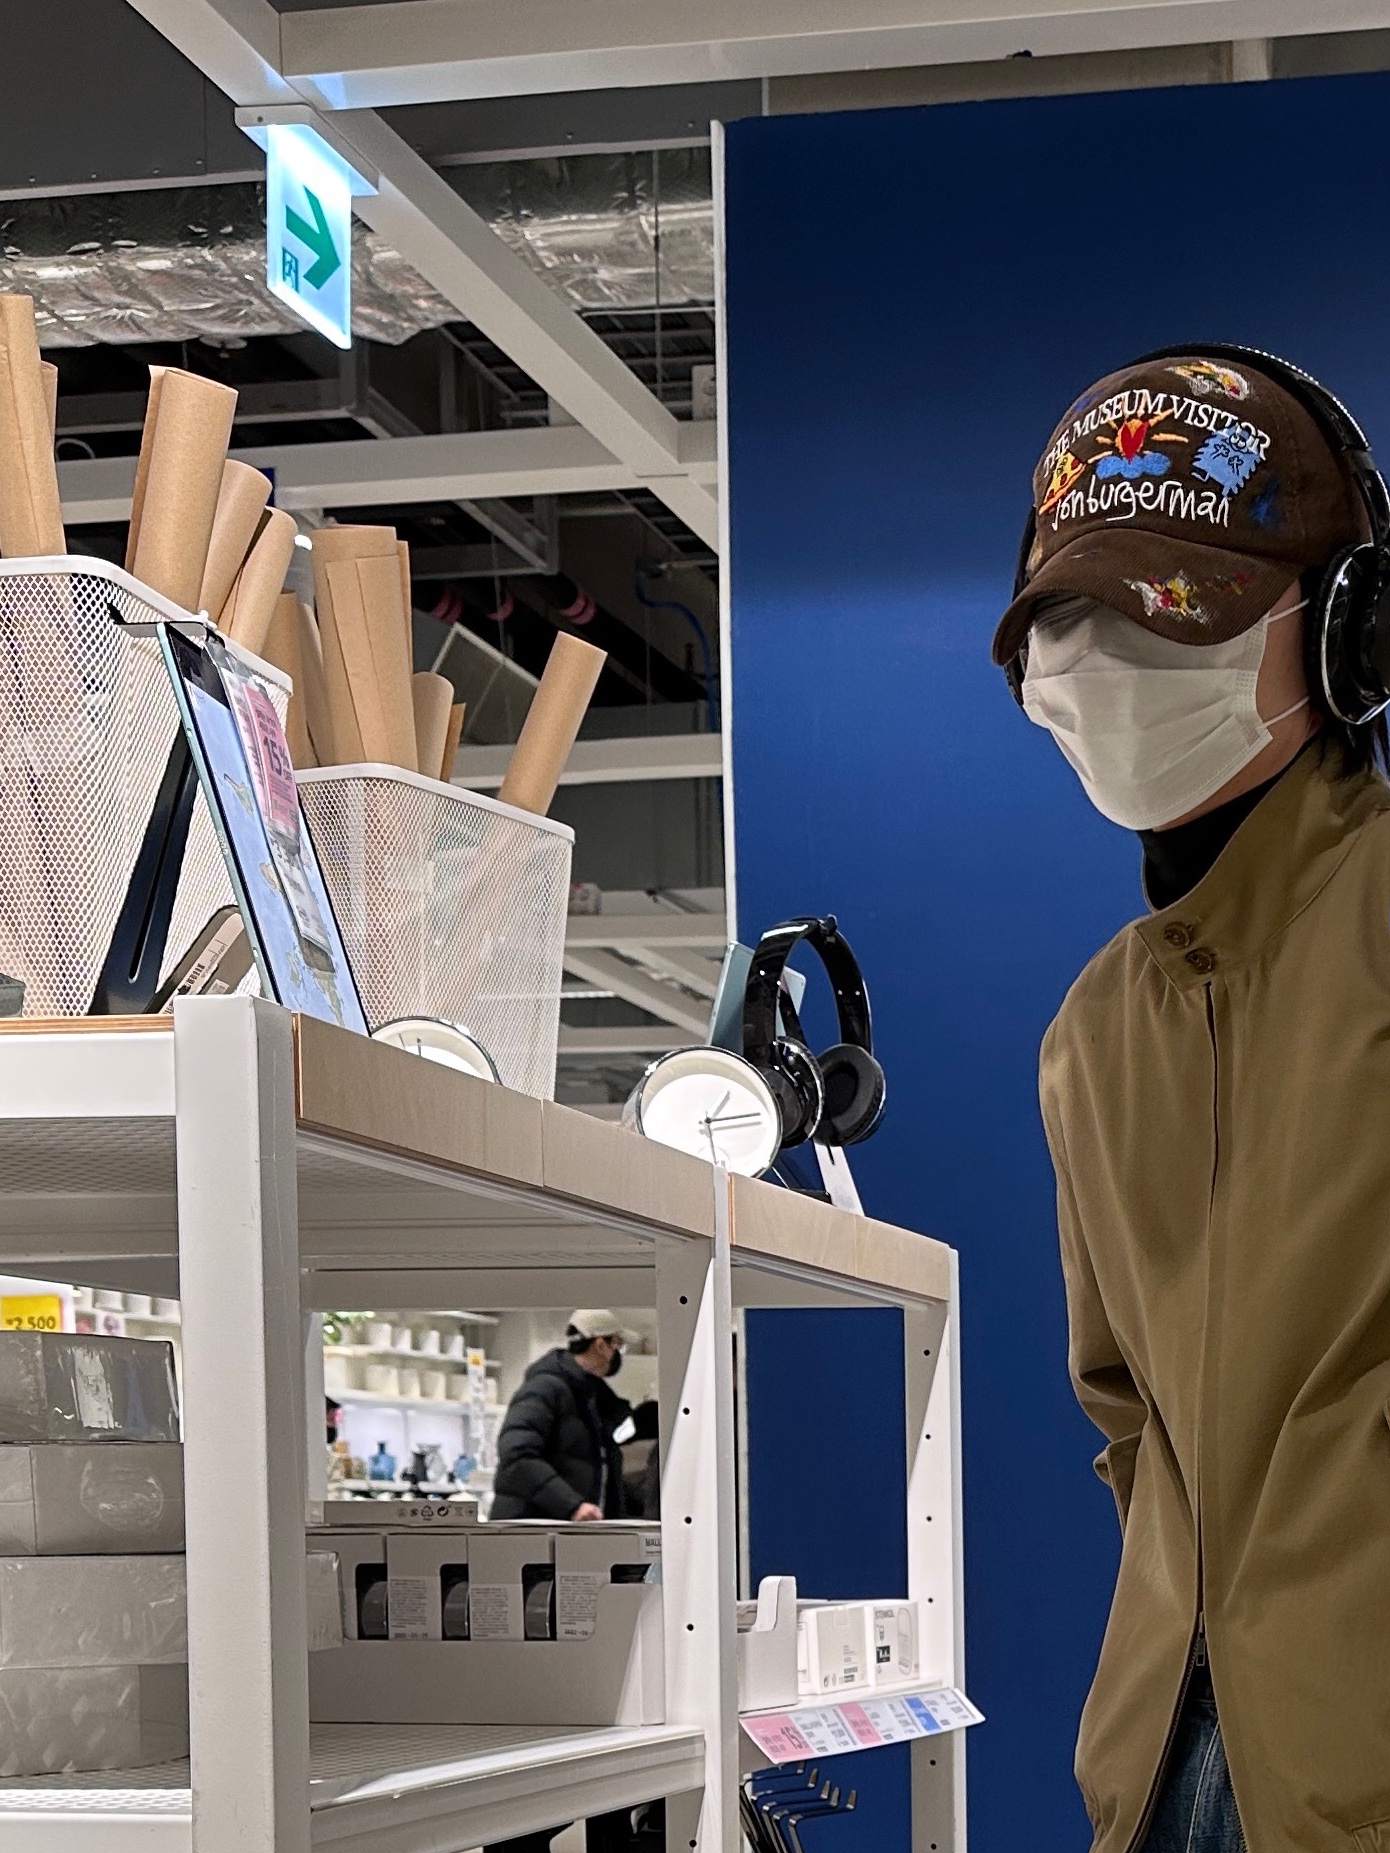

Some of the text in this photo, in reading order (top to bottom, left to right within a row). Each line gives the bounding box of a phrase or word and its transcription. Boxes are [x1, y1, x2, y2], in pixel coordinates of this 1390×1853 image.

[1043, 388, 1272, 478] THE MUSEUM VISITOR
